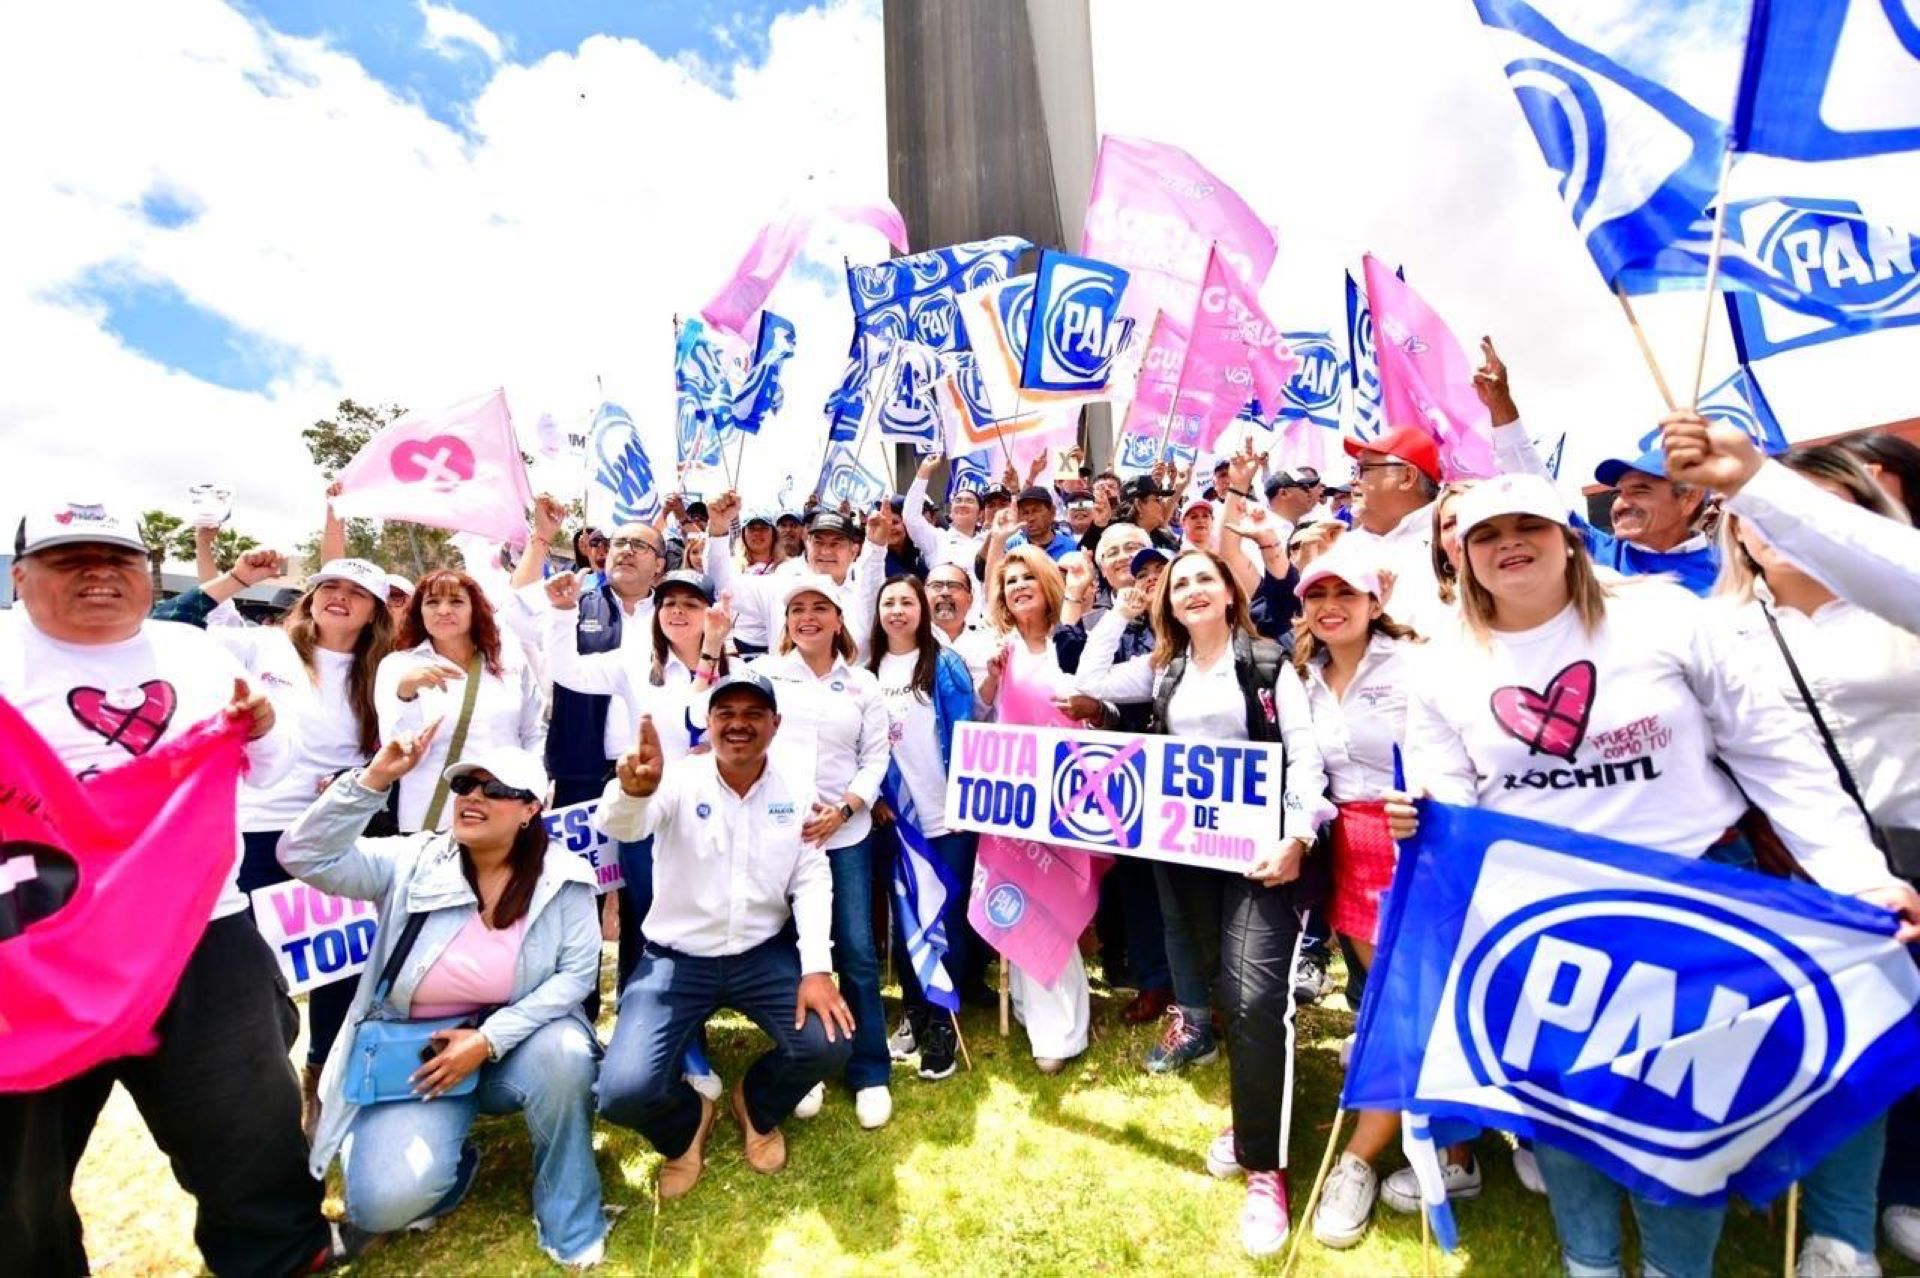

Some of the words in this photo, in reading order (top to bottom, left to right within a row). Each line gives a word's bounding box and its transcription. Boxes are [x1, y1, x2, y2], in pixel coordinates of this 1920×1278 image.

[1782, 220, 1917, 295] PAN
[1061, 301, 1126, 358] PAN
[961, 729, 1037, 778] VOTA
[1161, 743, 1268, 806] ESTE
[1603, 740, 1642, 759] COMO
[957, 777, 1037, 829] TODO
[1069, 768, 1126, 819] PAN
[1158, 801, 1188, 852] 2
[1194, 805, 1219, 830] DE
[1190, 832, 1256, 862] JUNIO
[578, 849, 600, 868] E
[990, 889, 1020, 920] PAN
[1501, 934, 1792, 1126] PAN
